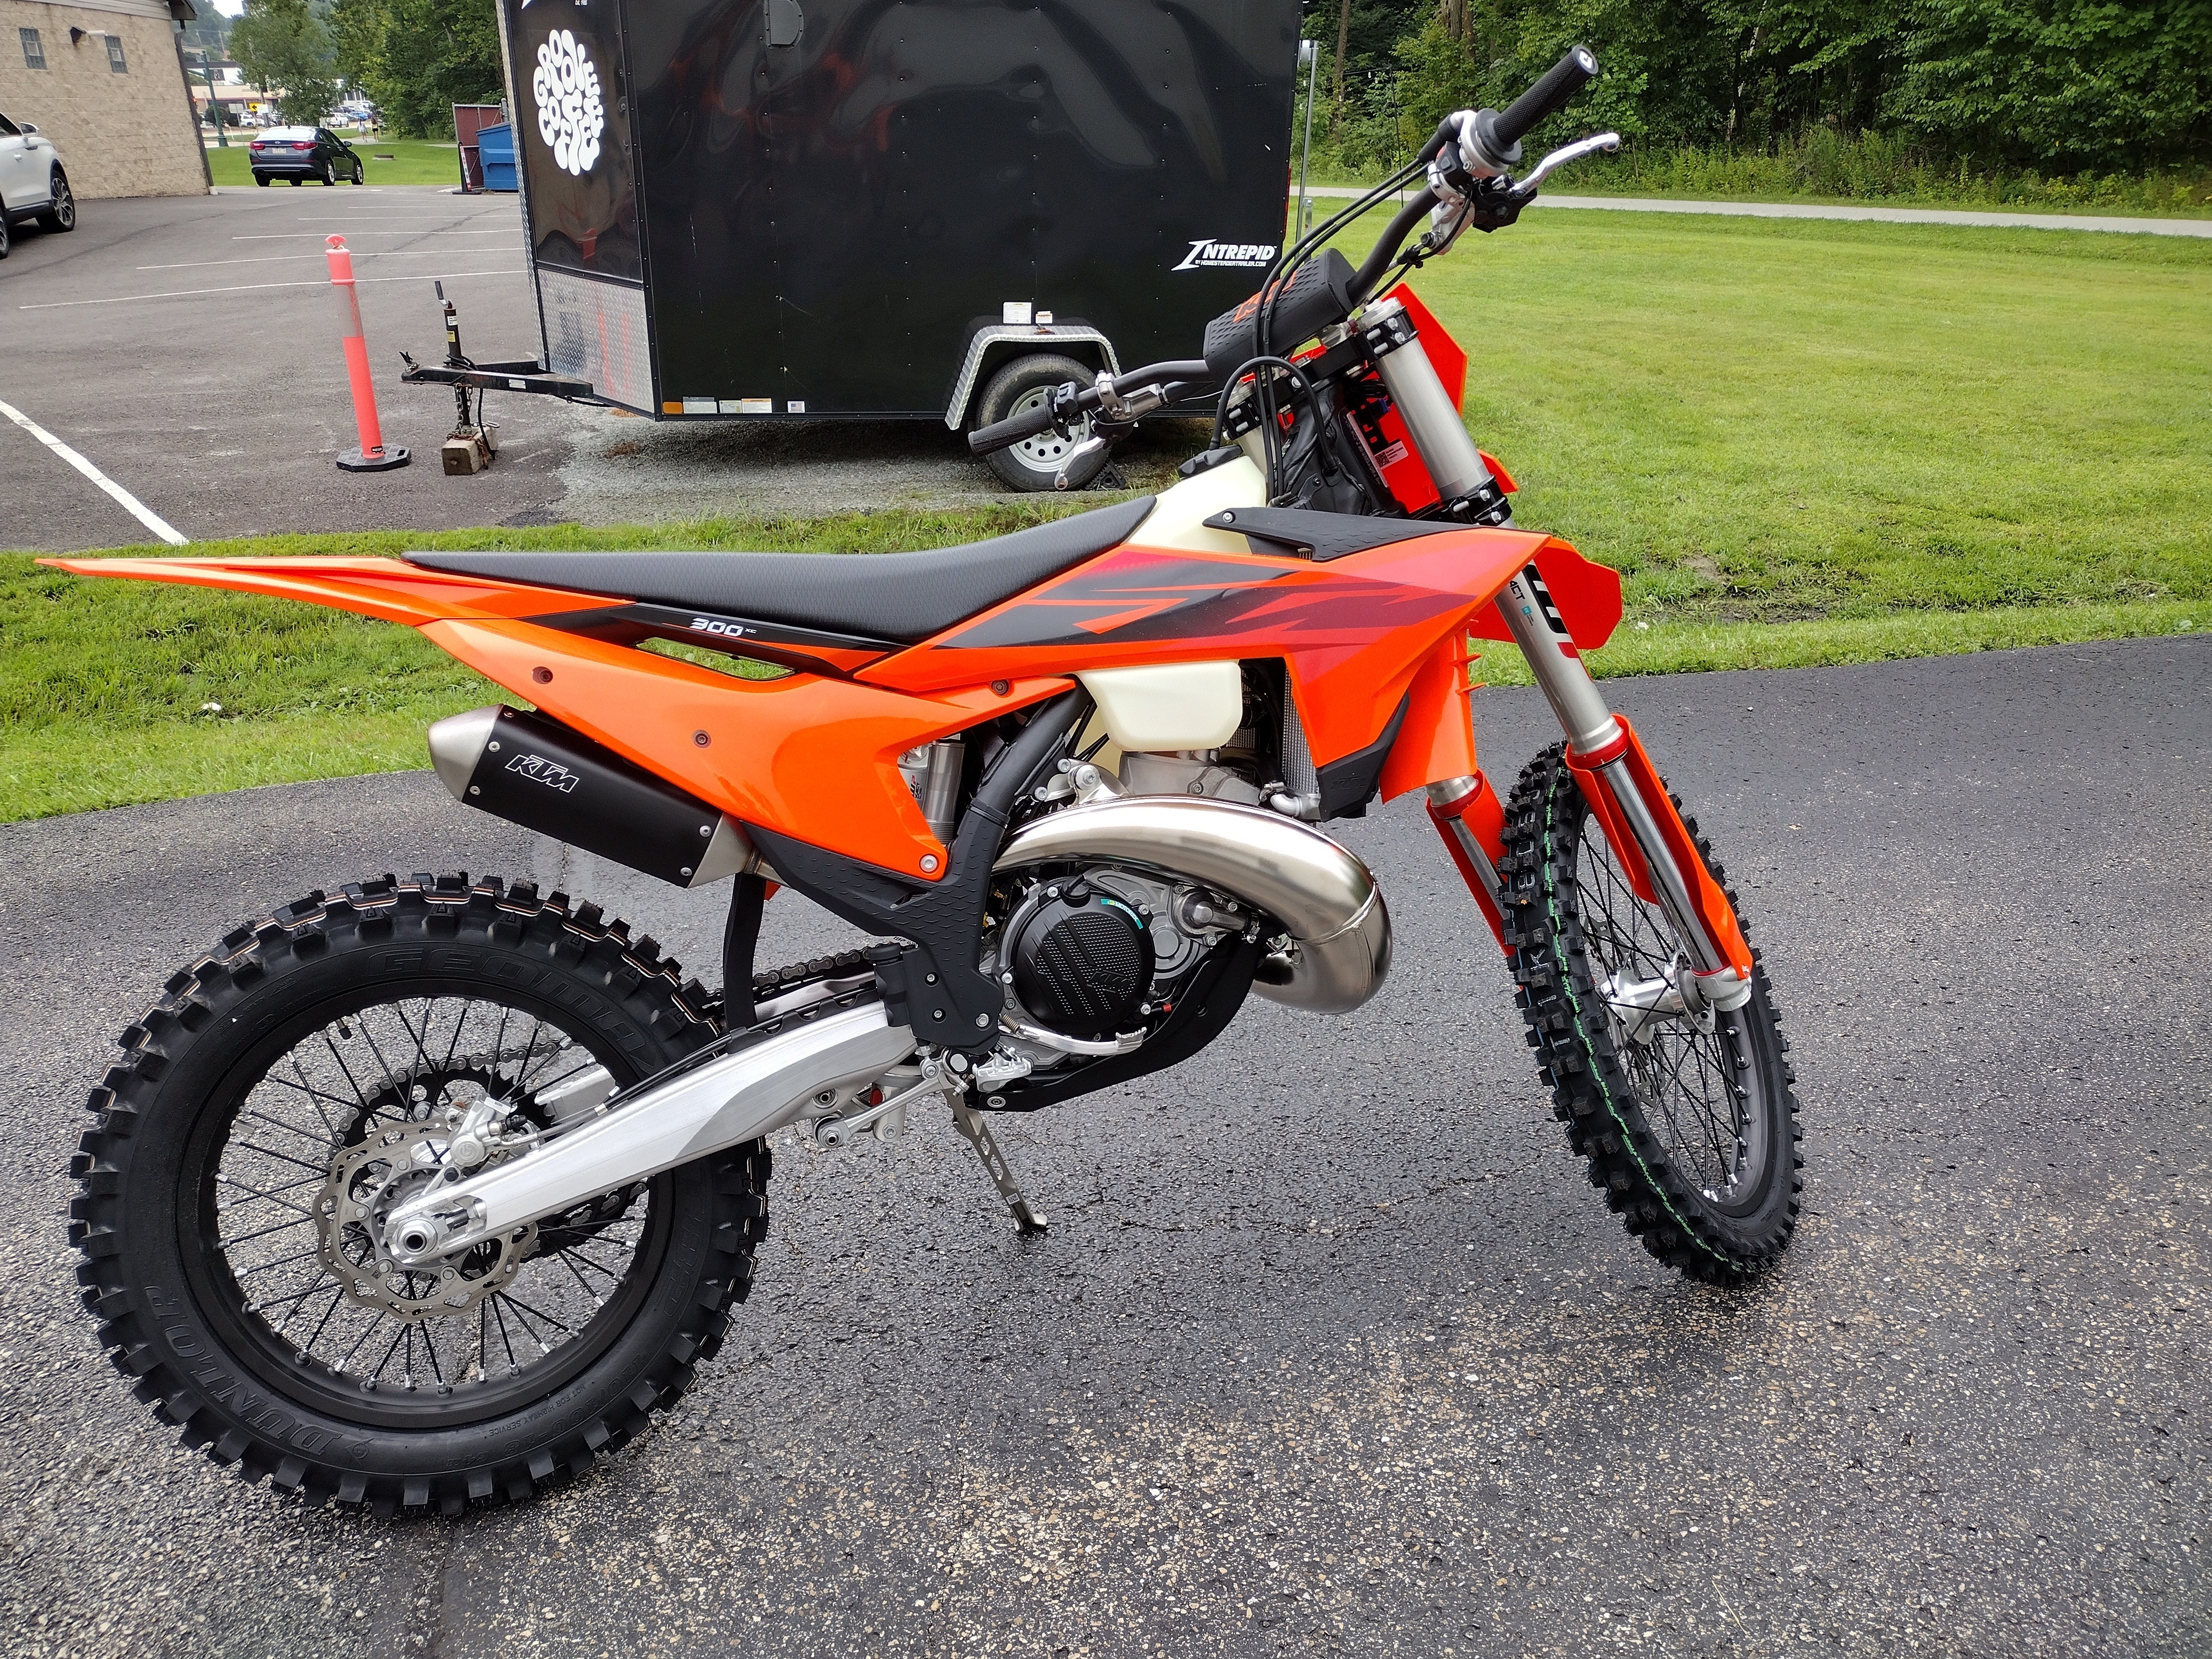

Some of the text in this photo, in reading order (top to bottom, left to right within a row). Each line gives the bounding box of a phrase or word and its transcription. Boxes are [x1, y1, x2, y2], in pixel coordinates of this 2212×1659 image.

[533, 29, 601, 100] GROOVE
[538, 88, 604, 176] COFFEE
[1171, 238, 1275, 271] INTREPID
[689, 618, 744, 637] 300
[504, 754, 580, 793] KTM
[144, 1285, 343, 1456] DUNLOP
[556, 1396, 571, 1407] FOR
[572, 1384, 586, 1397] NOT
[488, 1420, 521, 1436] SERVICE
